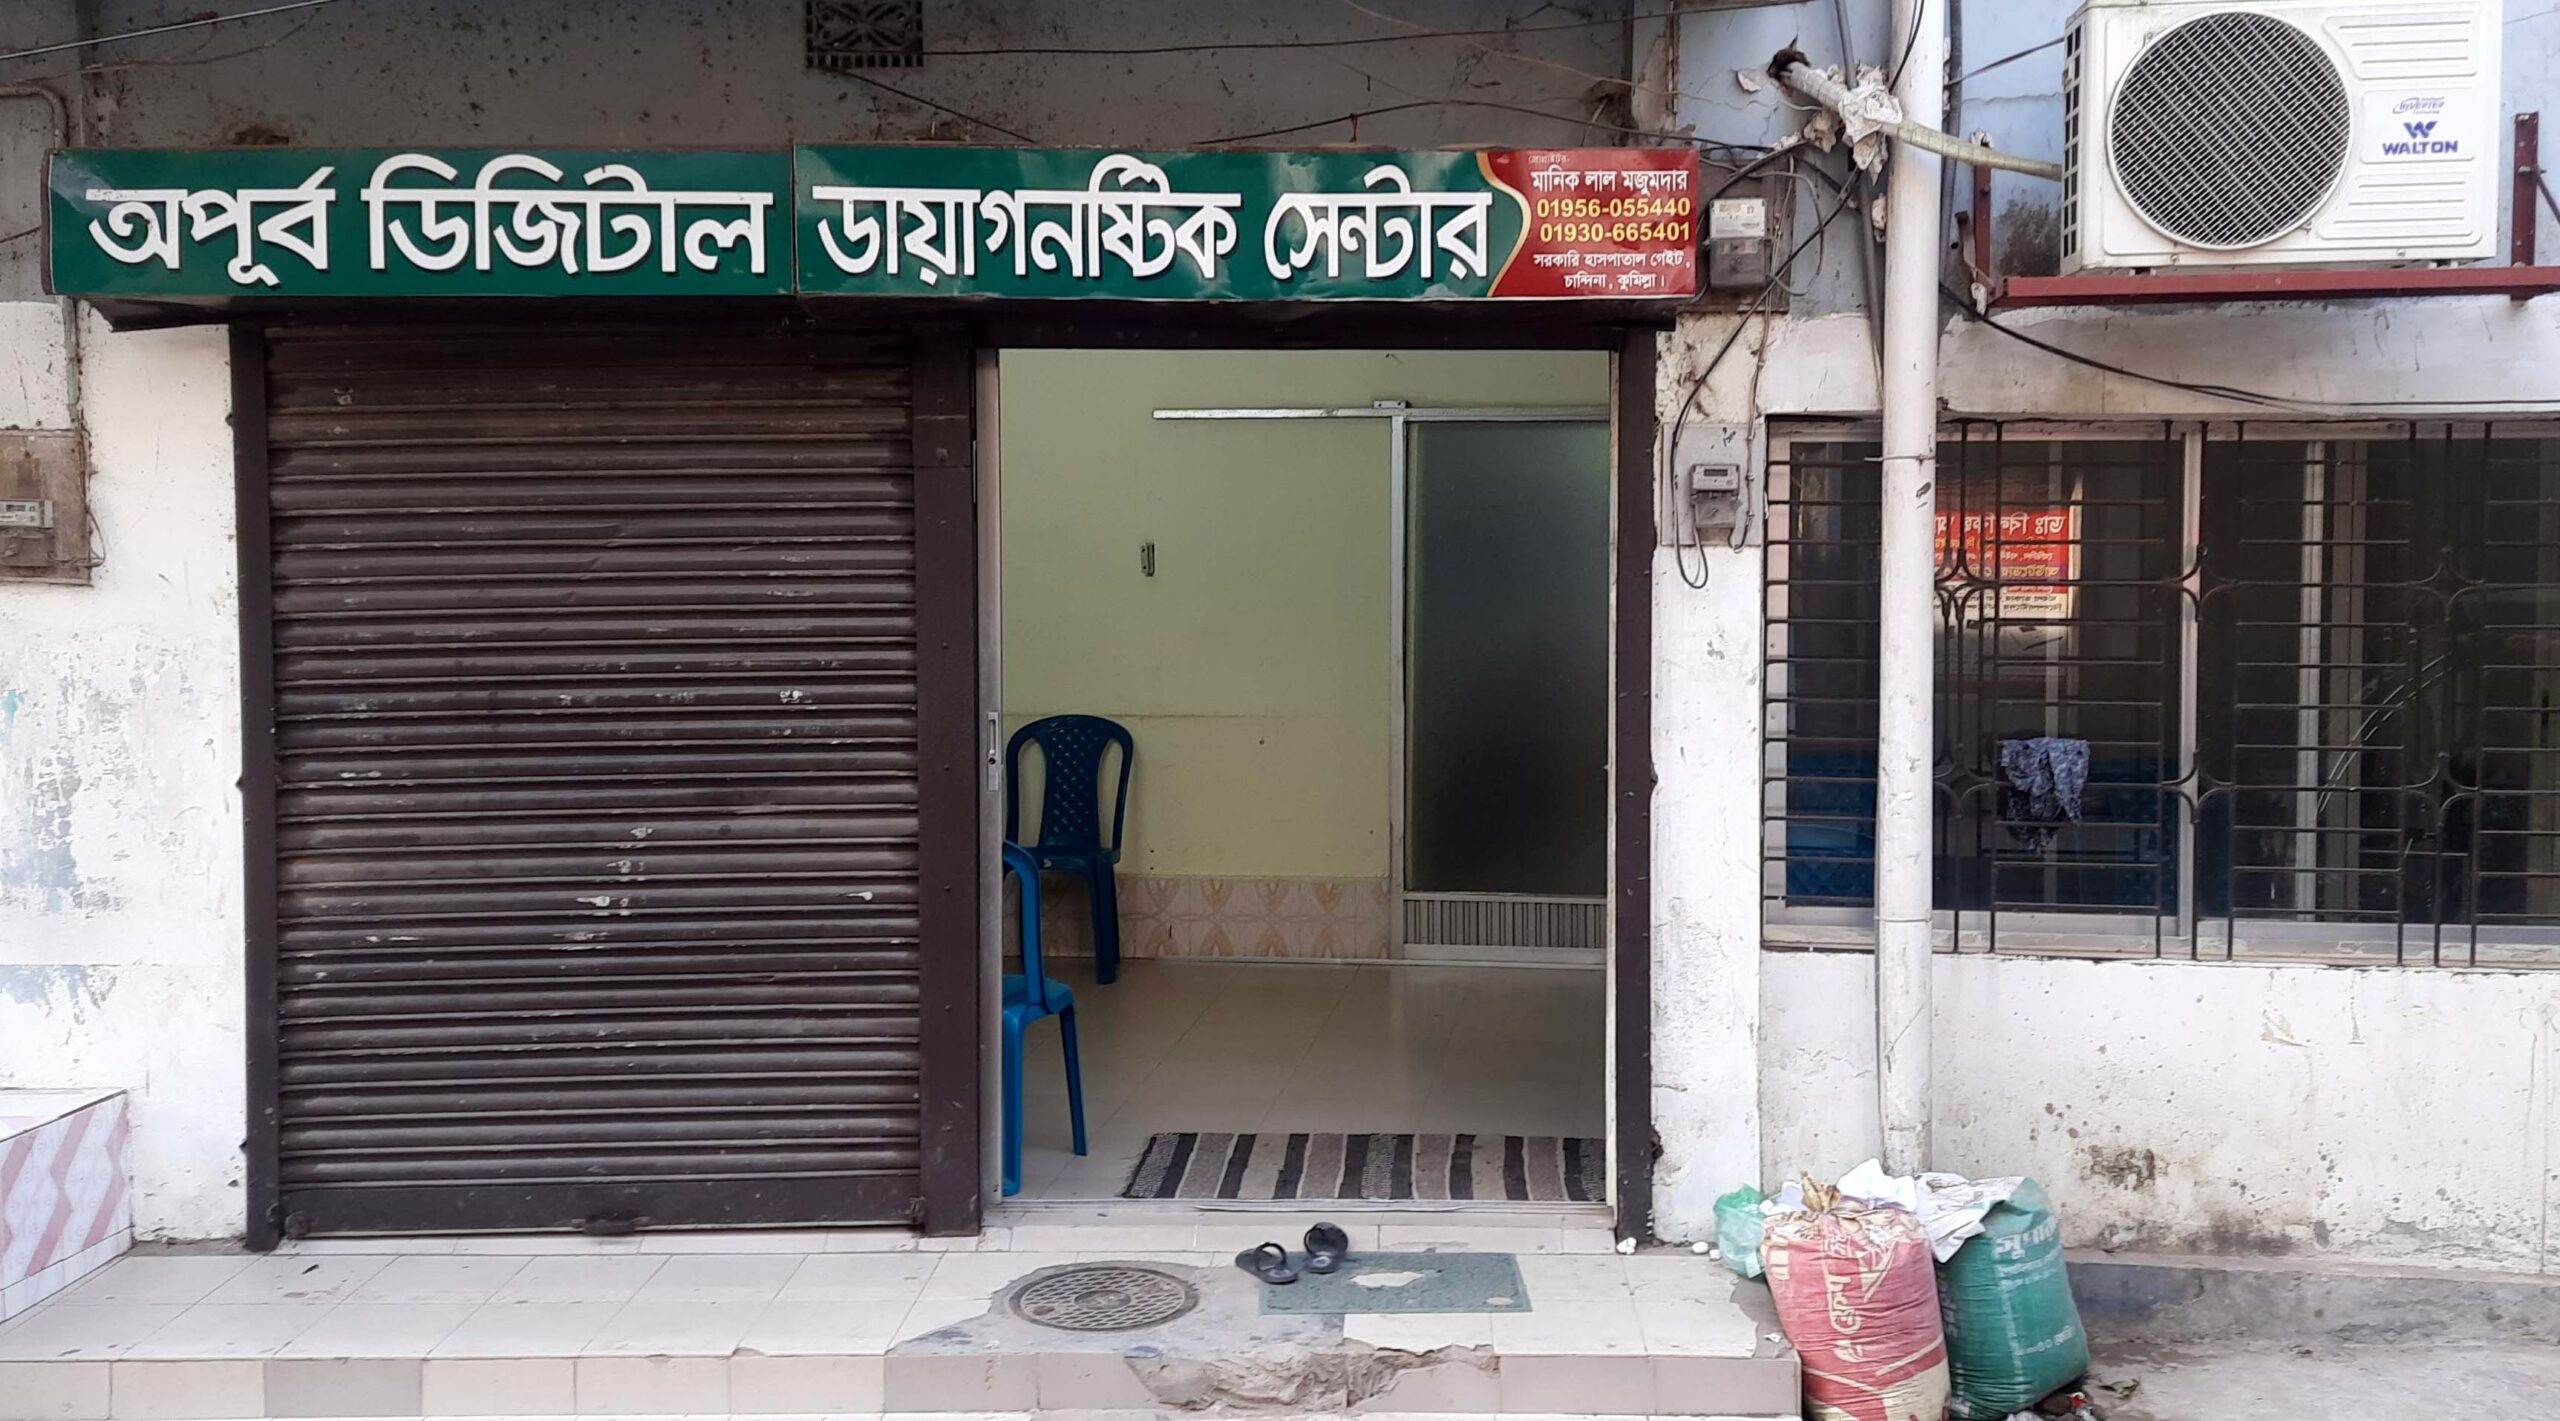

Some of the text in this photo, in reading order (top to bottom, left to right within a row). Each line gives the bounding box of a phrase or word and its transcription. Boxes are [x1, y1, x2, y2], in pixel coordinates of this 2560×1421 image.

[2382, 139, 2459, 156] WALTON
[1530, 164, 1689, 196] মানিক লাল মজুমদার
[1536, 197, 1691, 218] 01956-055440
[85, 153, 1493, 287] অপূর্ব ডিজিটাল ডায়াগনষ্টিক সেন্টার
[1540, 222, 1690, 242] 01930-665401
[1533, 250, 1580, 267] সরকারি
[1584, 252, 1647, 267] হাসপাতাল
